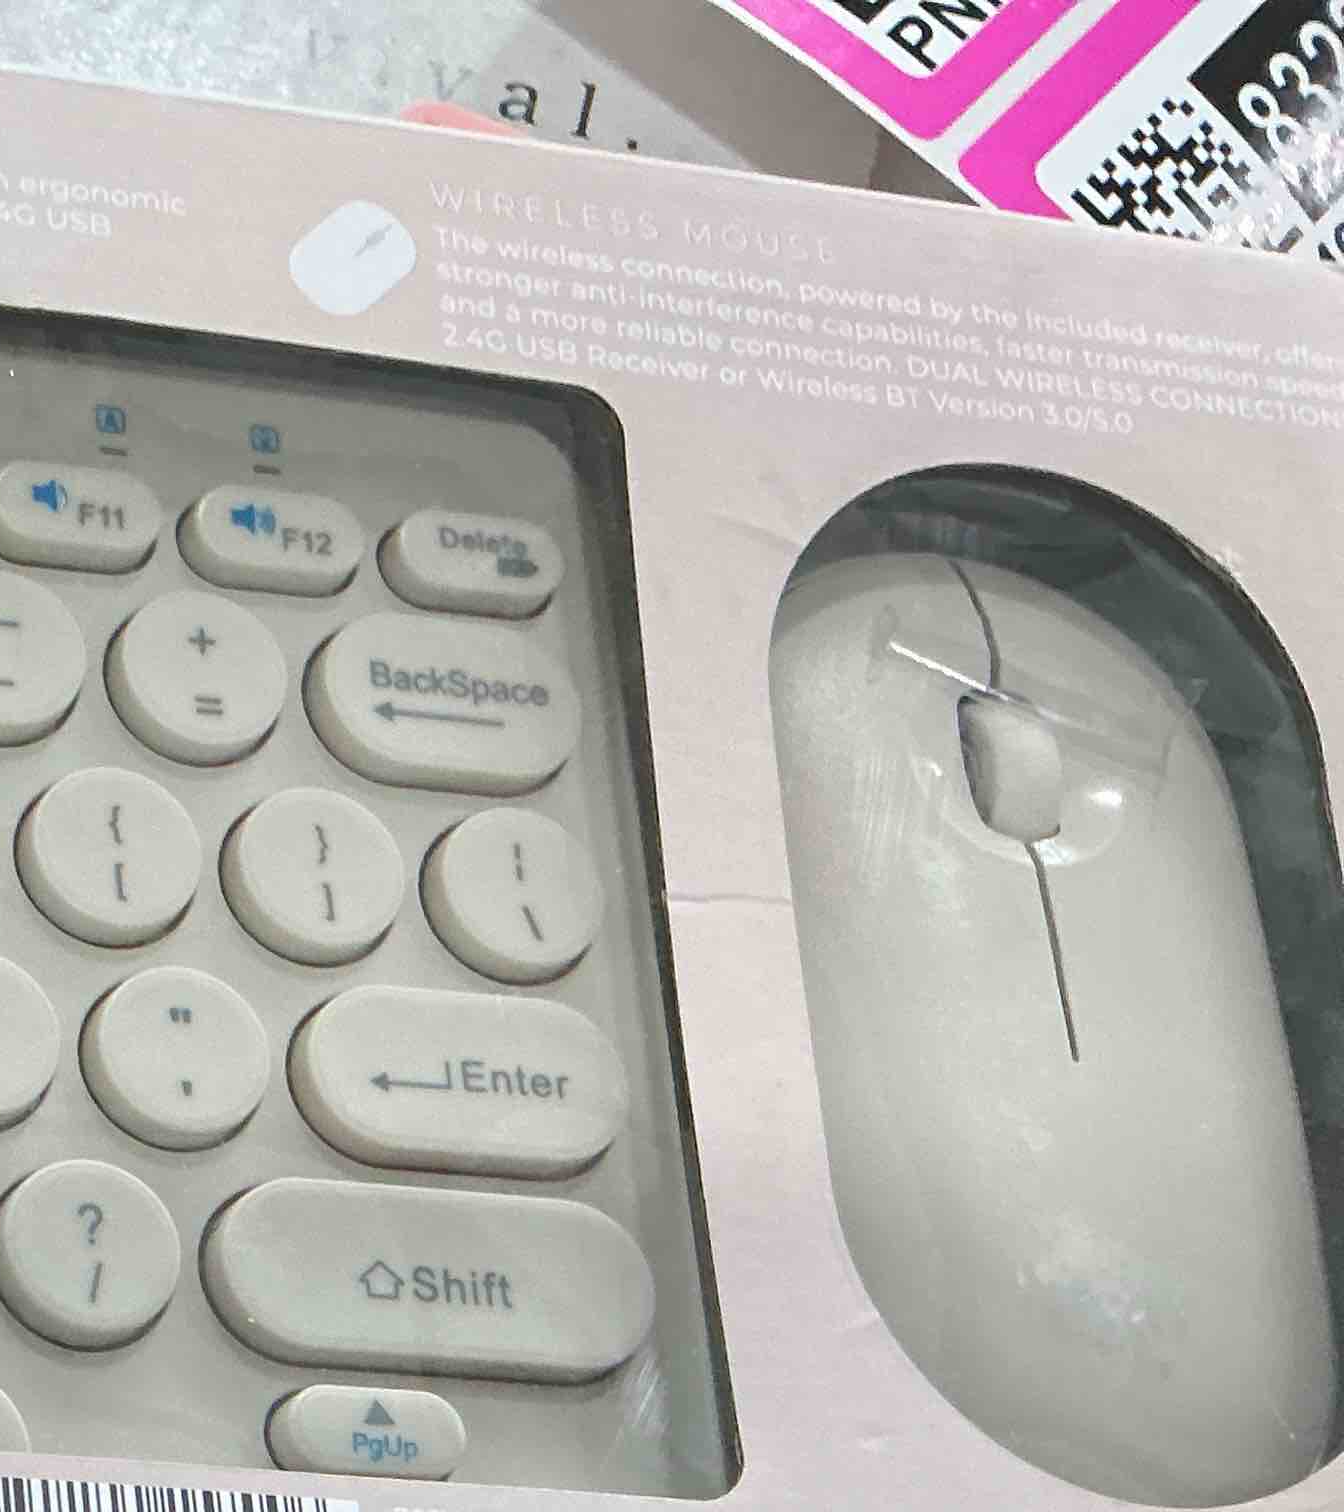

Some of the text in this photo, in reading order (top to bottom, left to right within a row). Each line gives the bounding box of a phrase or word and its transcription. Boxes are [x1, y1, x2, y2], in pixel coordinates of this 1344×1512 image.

[19, 176, 188, 217] ergonomic
[47, 209, 112, 238] USB
[429, 182, 836, 266] WIRELESS MOUSE
[435, 226, 1147, 346] The wireless connection, powered included
[435, 260, 561, 299] stronger
[571, 281, 813, 332] anti-interference
[997, 335, 1074, 365] faster
[1083, 346, 1260, 389] transmission
[439, 293, 496, 320] and
[531, 308, 607, 335] more
[617, 319, 724, 352] reliable
[907, 355, 988, 387] DUAL
[994, 366, 1146, 408] WIRELESS
[444, 320, 1135, 435] 2.4G USB Receiver Wireless Version 3.0/5.0
[77, 502, 125, 531] F11
[281, 526, 333, 557] F12
[368, 659, 551, 709] BackSpace
[462, 1058, 570, 1101] Enter
[412, 1264, 515, 1310] Shift
[351, 1431, 419, 1464] PgUp
